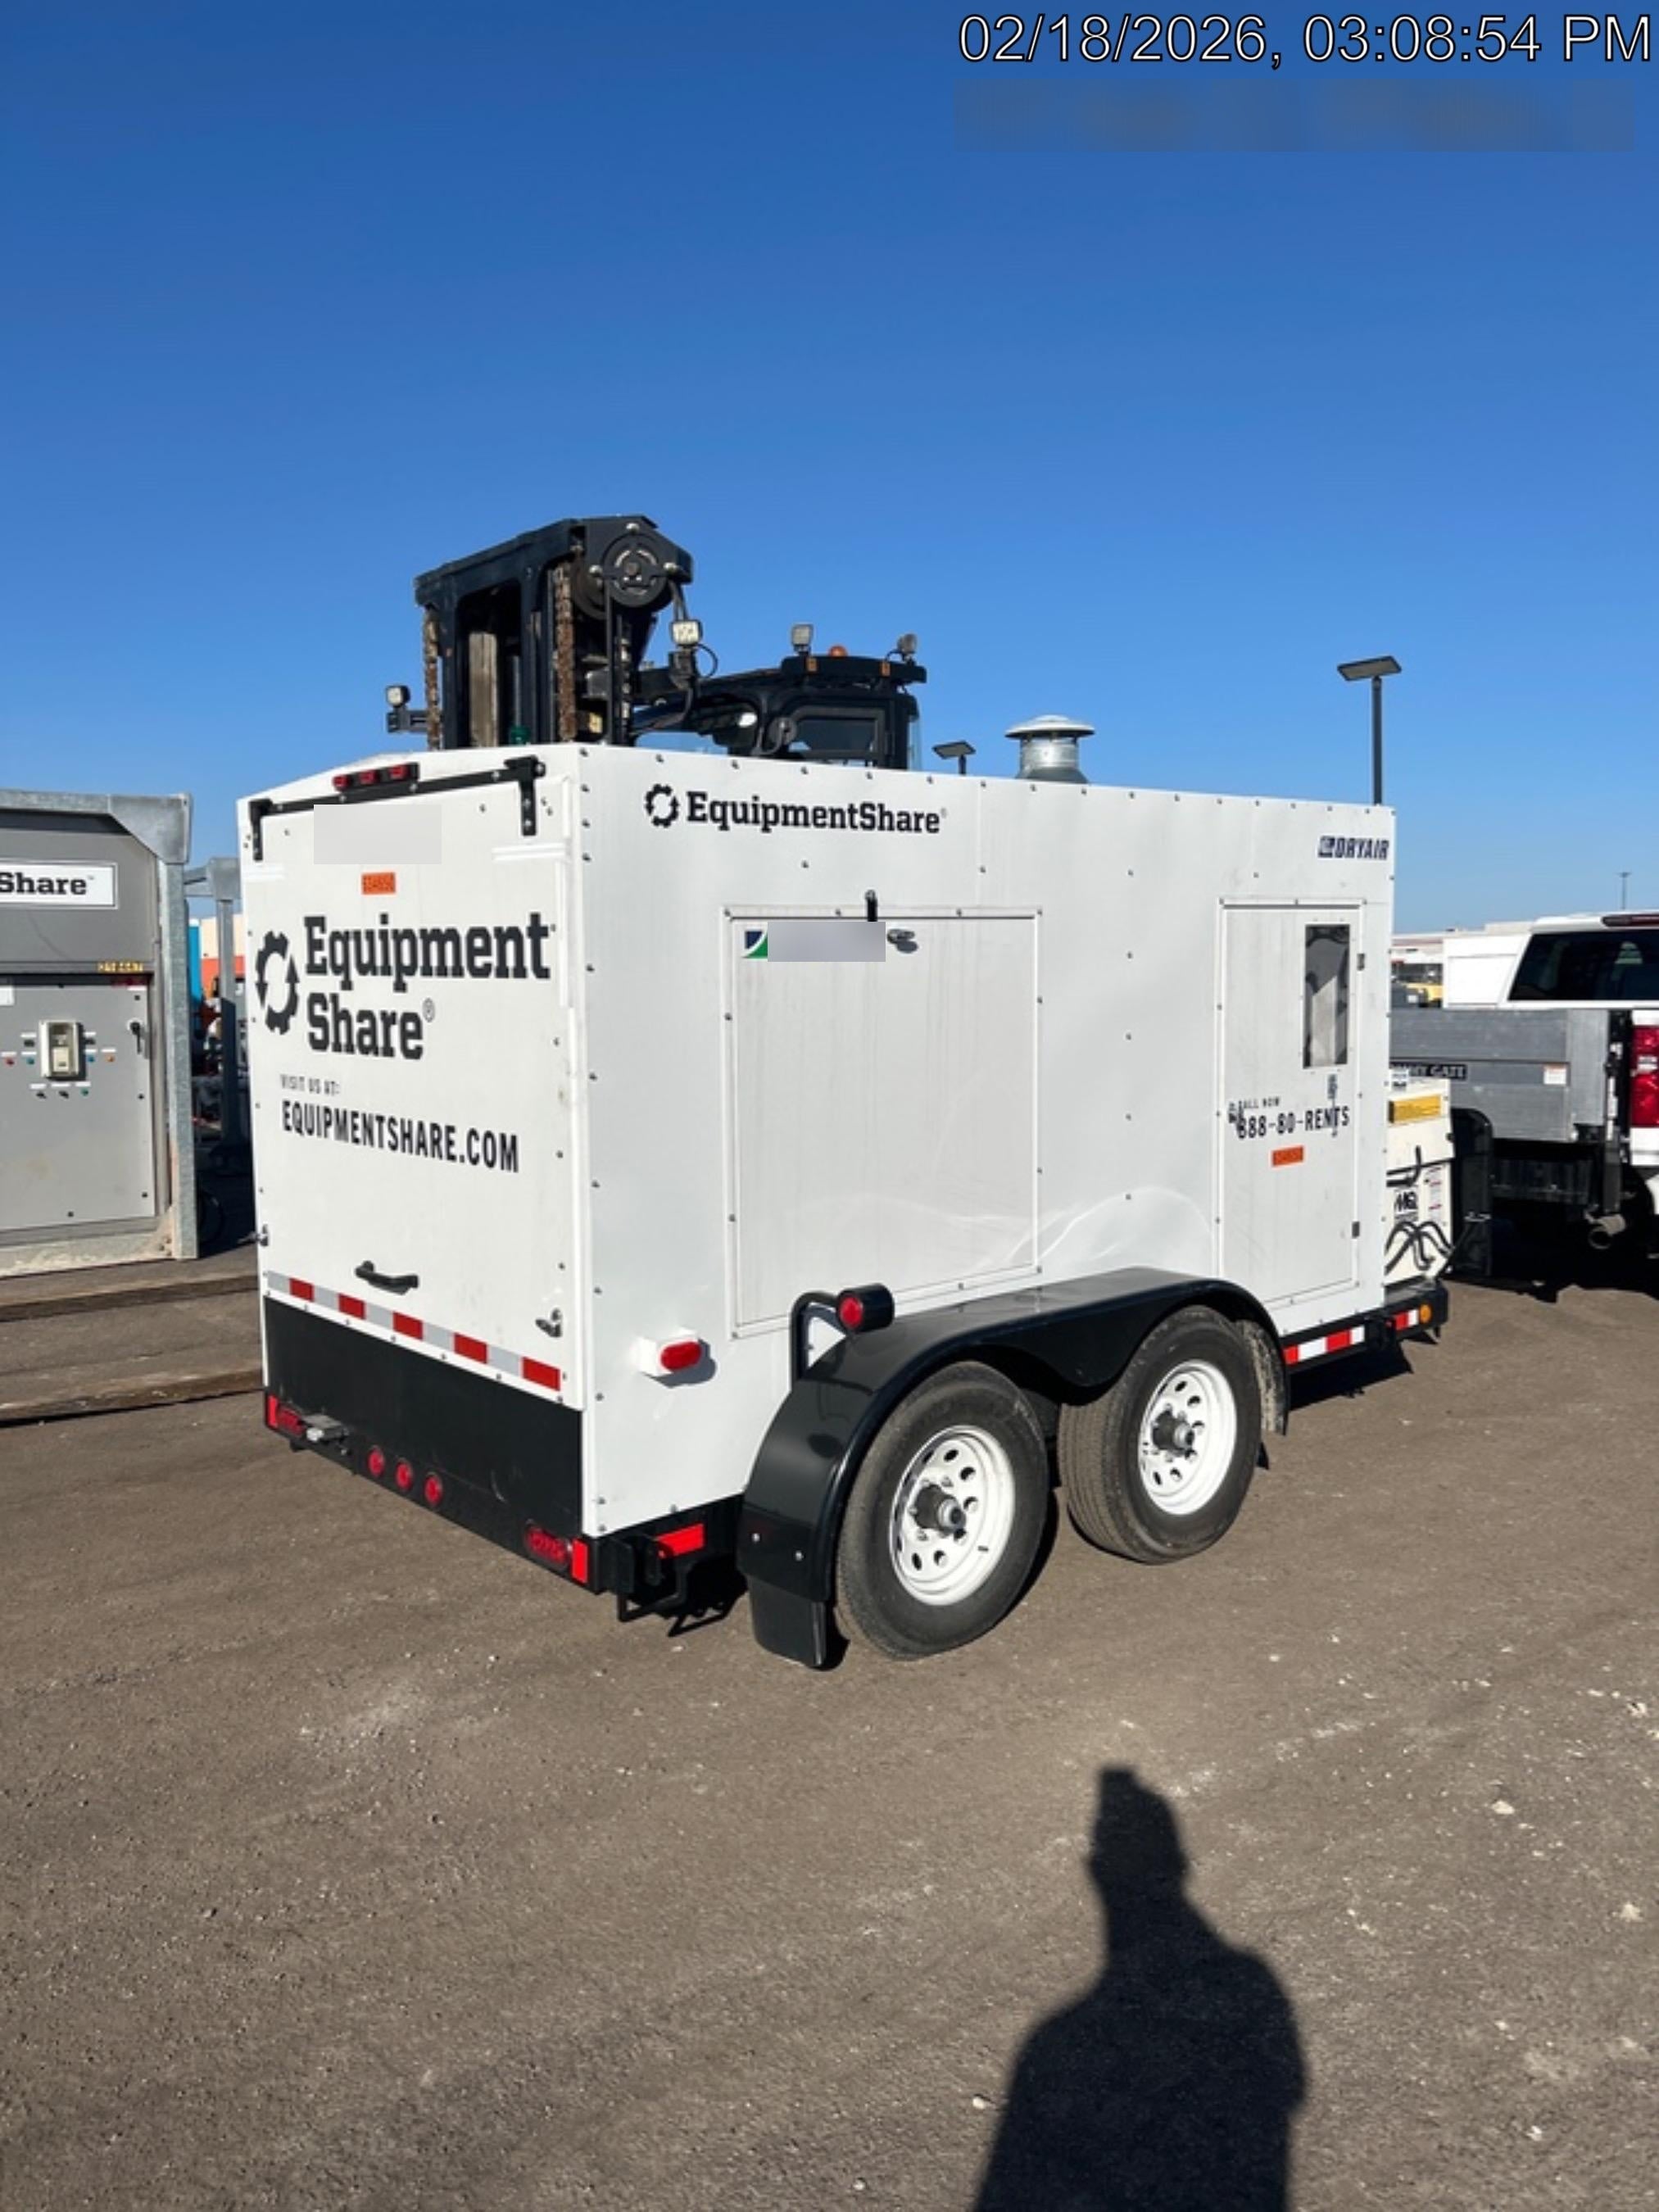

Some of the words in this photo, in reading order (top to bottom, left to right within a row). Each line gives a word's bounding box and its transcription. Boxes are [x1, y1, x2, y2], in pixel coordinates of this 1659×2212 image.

[687, 791, 941, 832] EquipmentShare
[304, 912, 551, 993] Equipment
[283, 1099, 519, 1173] EQUIPMENTSHARE.COM
